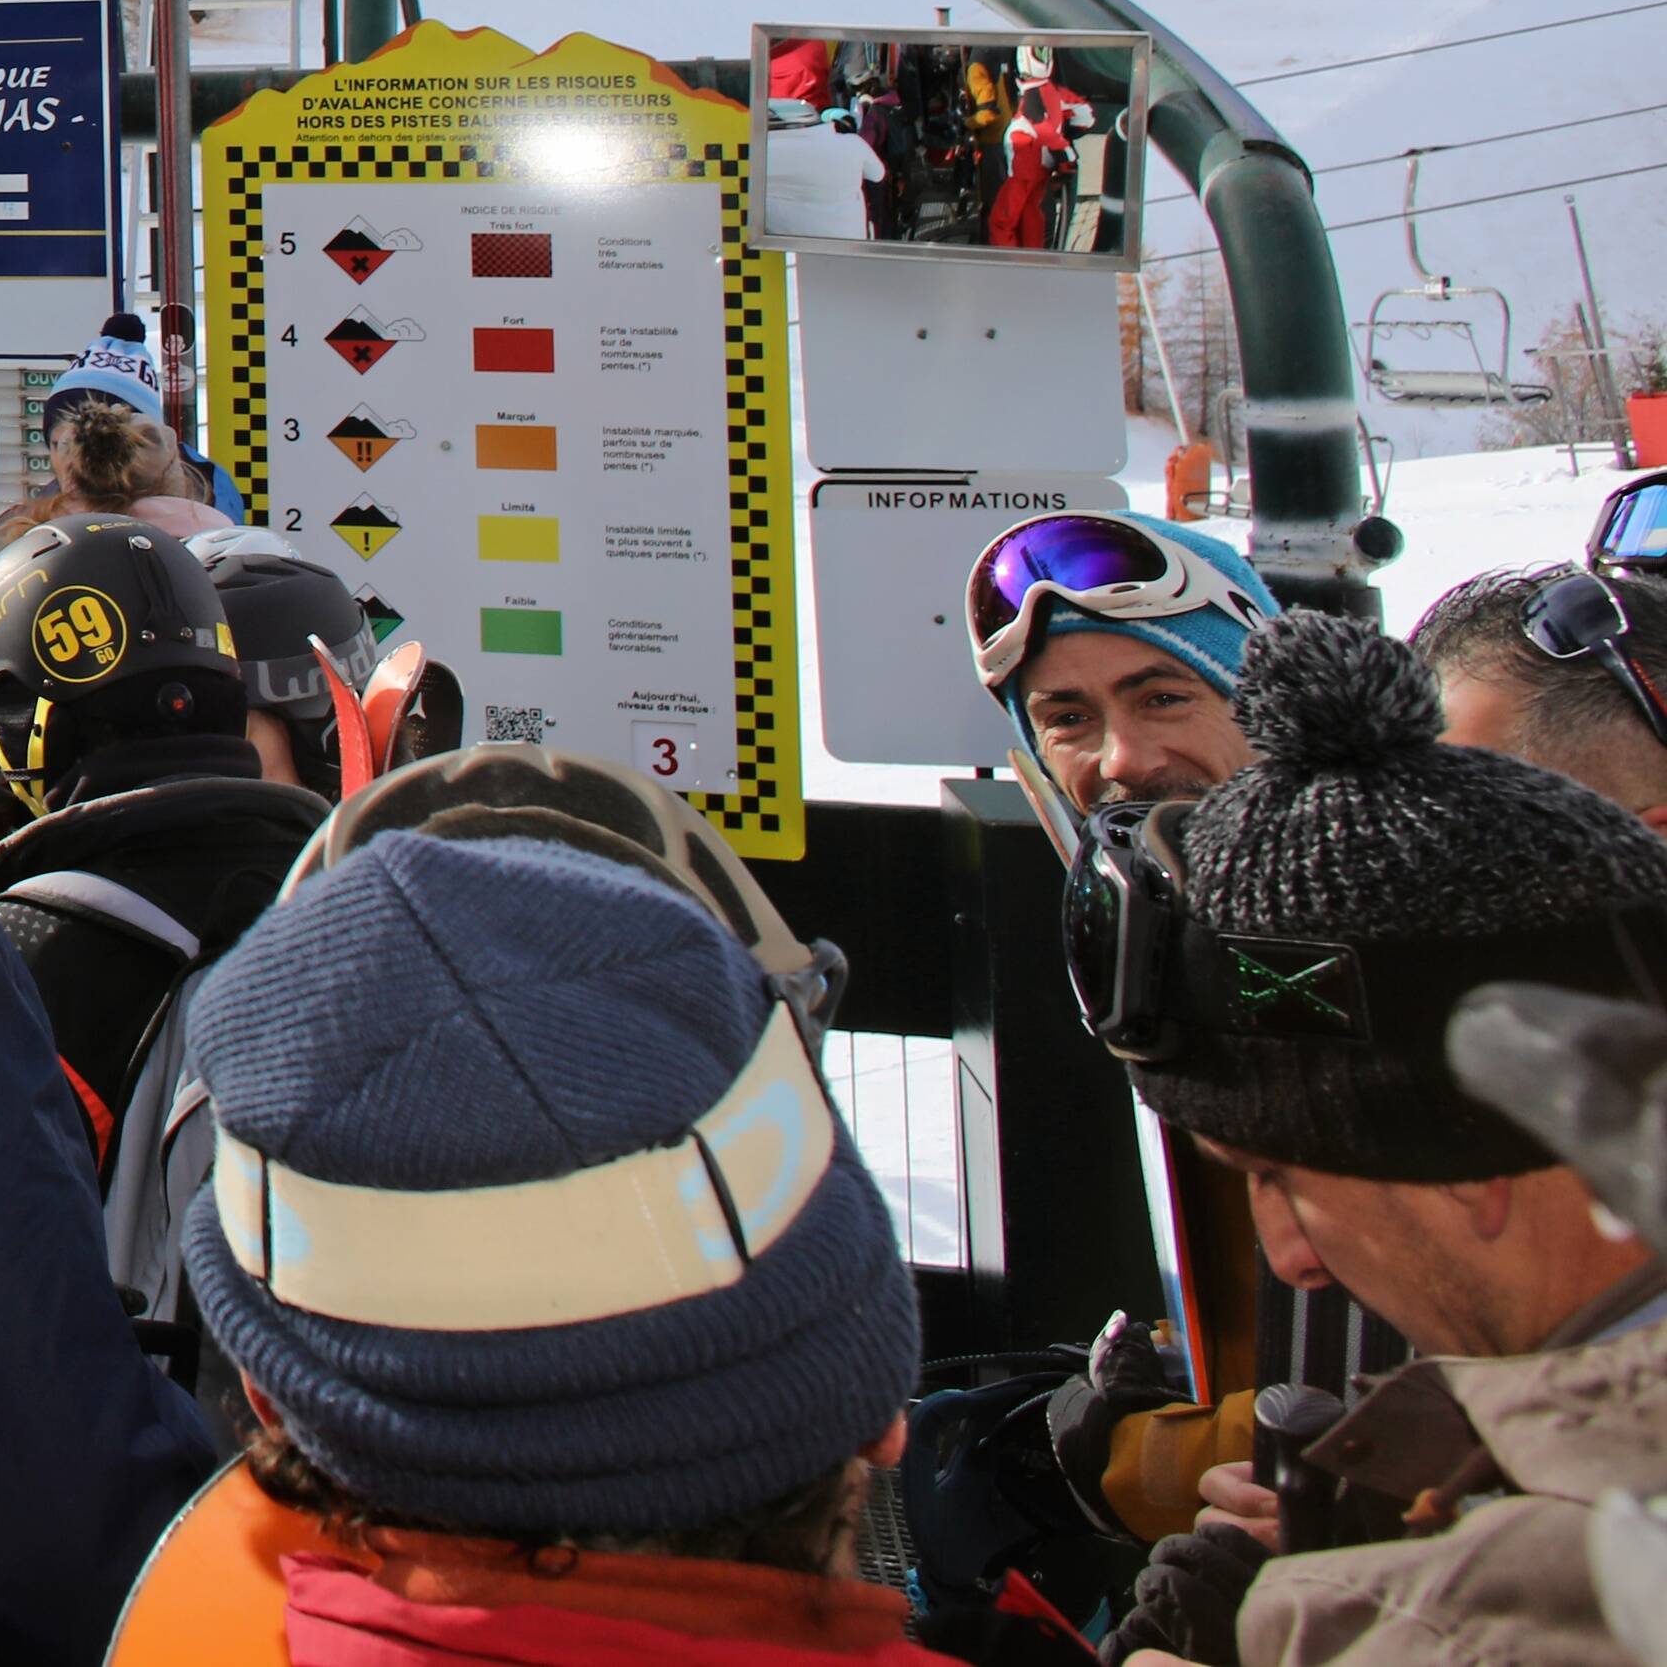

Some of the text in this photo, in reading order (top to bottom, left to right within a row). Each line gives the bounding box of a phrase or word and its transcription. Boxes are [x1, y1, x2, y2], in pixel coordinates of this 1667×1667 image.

[334, 75, 636, 92] L'INFORMATION SUR LES RISQUES
[302, 96, 423, 111] D'AVALANCHE
[429, 95, 529, 110] CONCERNE
[574, 93, 672, 108] SECTEURS
[297, 115, 345, 129] HORS
[351, 115, 385, 129] DES
[392, 114, 452, 128] PISTES
[280, 232, 296, 255] 5
[503, 316, 524, 325] Fort
[281, 324, 298, 347] 4
[600, 326, 626, 335] Forte
[284, 418, 300, 441] 3
[867, 491, 1067, 510] INFORMATIONS
[286, 508, 302, 531] 2
[505, 596, 537, 606] Faible
[38, 596, 113, 663] 59
[95, 646, 116, 665] 60
[652, 737, 679, 776] 3
